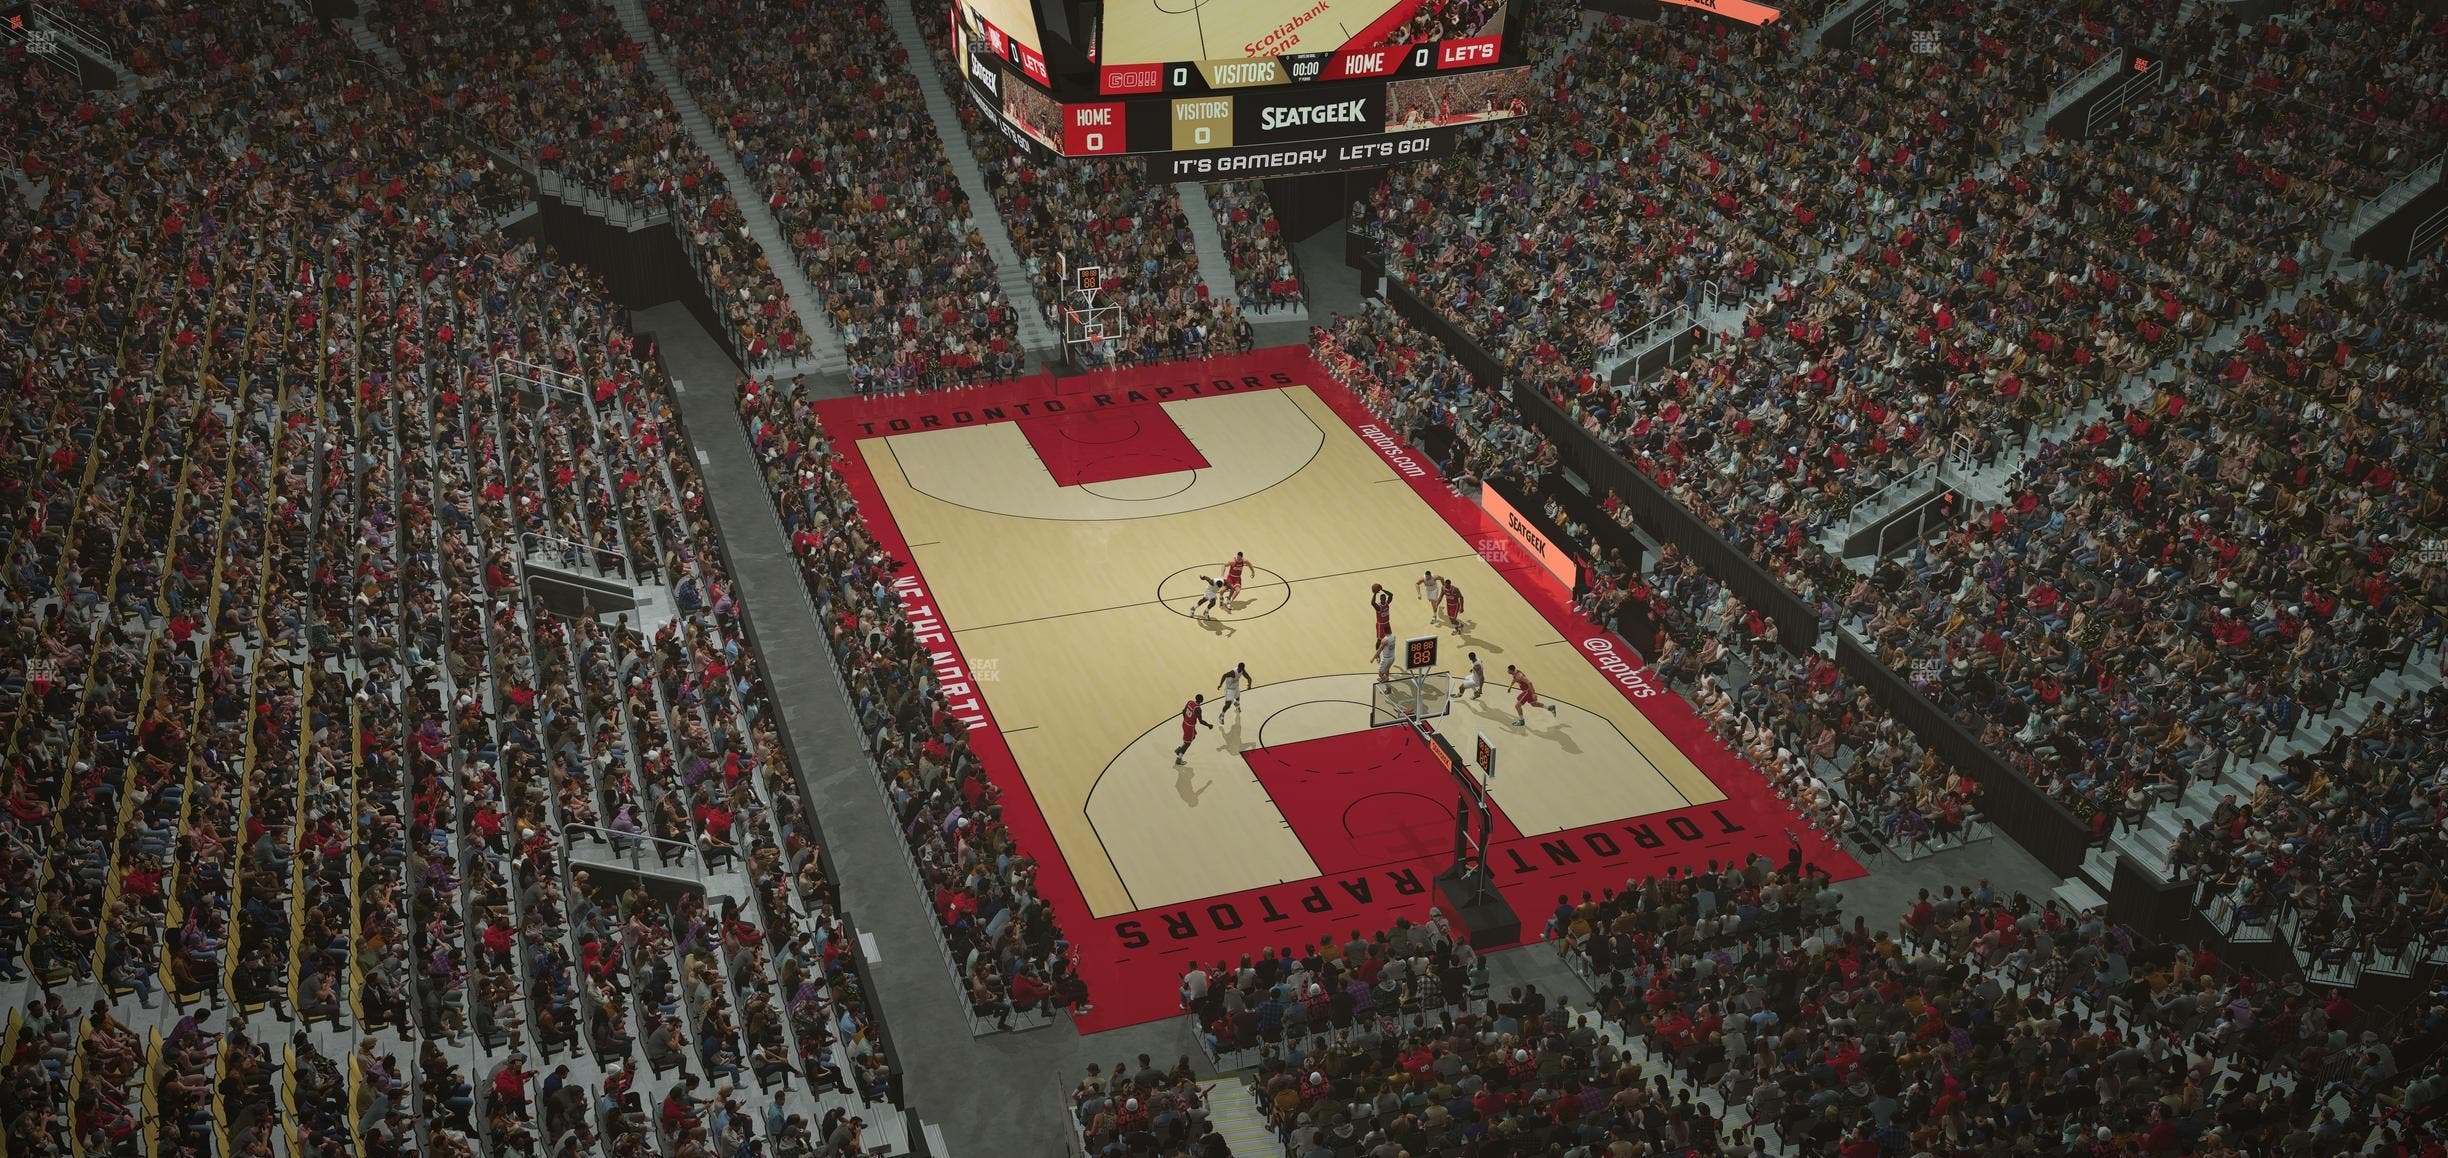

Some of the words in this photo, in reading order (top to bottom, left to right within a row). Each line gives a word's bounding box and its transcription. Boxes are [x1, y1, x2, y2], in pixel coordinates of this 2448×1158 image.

[1244, 0, 1330, 58] Scotiabank
[1262, 32, 1301, 58] rena
[1415, 48, 1429, 67] 0
[1444, 43, 1494, 63] LET'S
[1022, 51, 1047, 79] LET'S
[1213, 61, 1276, 85] VISITORS
[1292, 61, 1320, 77] 00:00
[1345, 52, 1385, 75] HOME
[1108, 70, 1158, 88] GO!!!
[1173, 67, 1188, 87] 0
[1076, 108, 1112, 127] HOME
[1176, 101, 1229, 121] VISITORS
[1261, 98, 1367, 131] SEATGEEK
[1086, 133, 1104, 151] 0
[1194, 127, 1211, 145] 0
[1173, 158, 1212, 175] IT'S
[1217, 149, 1327, 171] GAMEDAY
[1339, 141, 1393, 162] LET'S
[1398, 138, 1430, 155] GO!
[857, 400, 1066, 436] TORONTO
[1092, 371, 1294, 407] RAPTORS
[1358, 424, 1427, 477] raptors.com
[1508, 511, 1547, 559] SEATGEEK
[1583, 637, 1657, 698] @raptors
[1465, 809, 1745, 880] TORONT
[1113, 868, 1426, 949] RAPTORS
